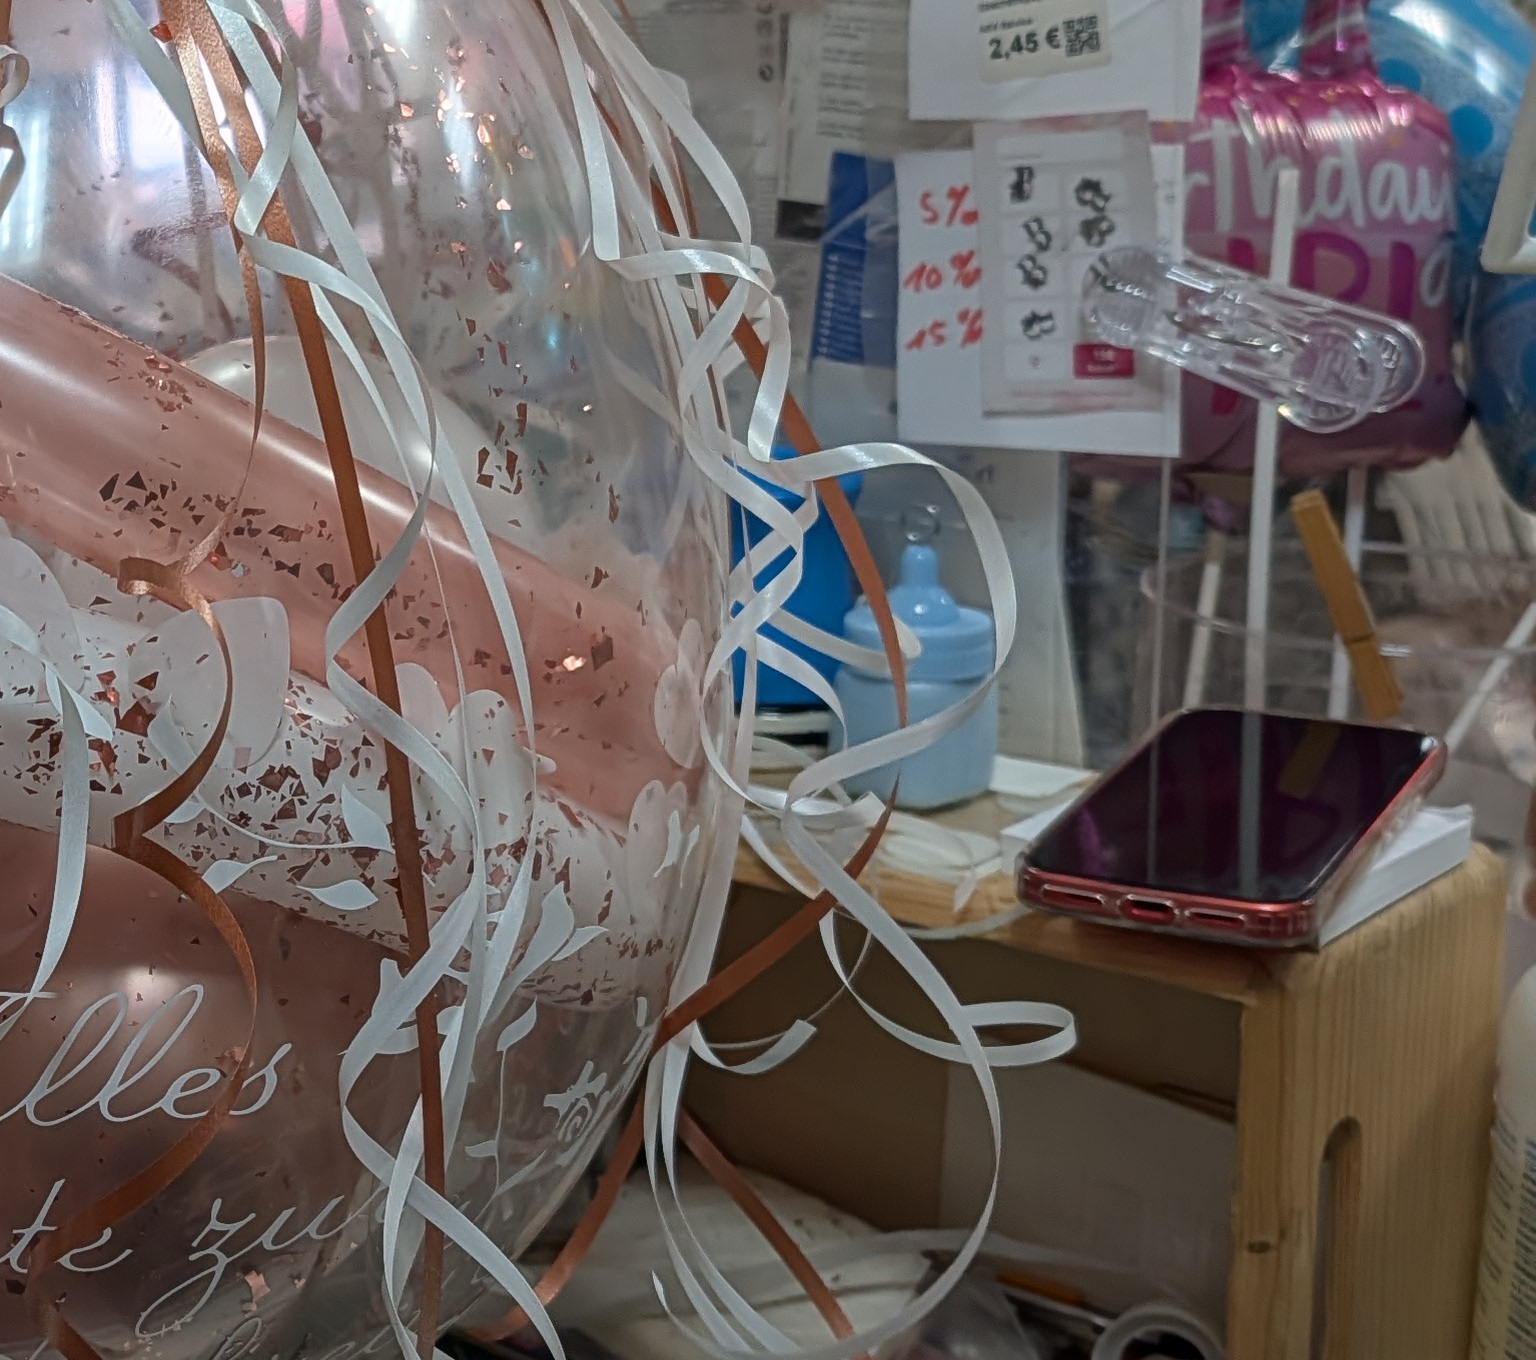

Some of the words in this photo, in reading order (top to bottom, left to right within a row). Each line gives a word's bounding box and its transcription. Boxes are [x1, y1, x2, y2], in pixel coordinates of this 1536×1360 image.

[988, 29, 1039, 60] 2,45
[1044, 25, 1061, 50] €
[920, 190, 940, 225] 5
[902, 262, 943, 295] 10
[904, 320, 948, 352] 15
[135, 1180, 389, 1338] zu
